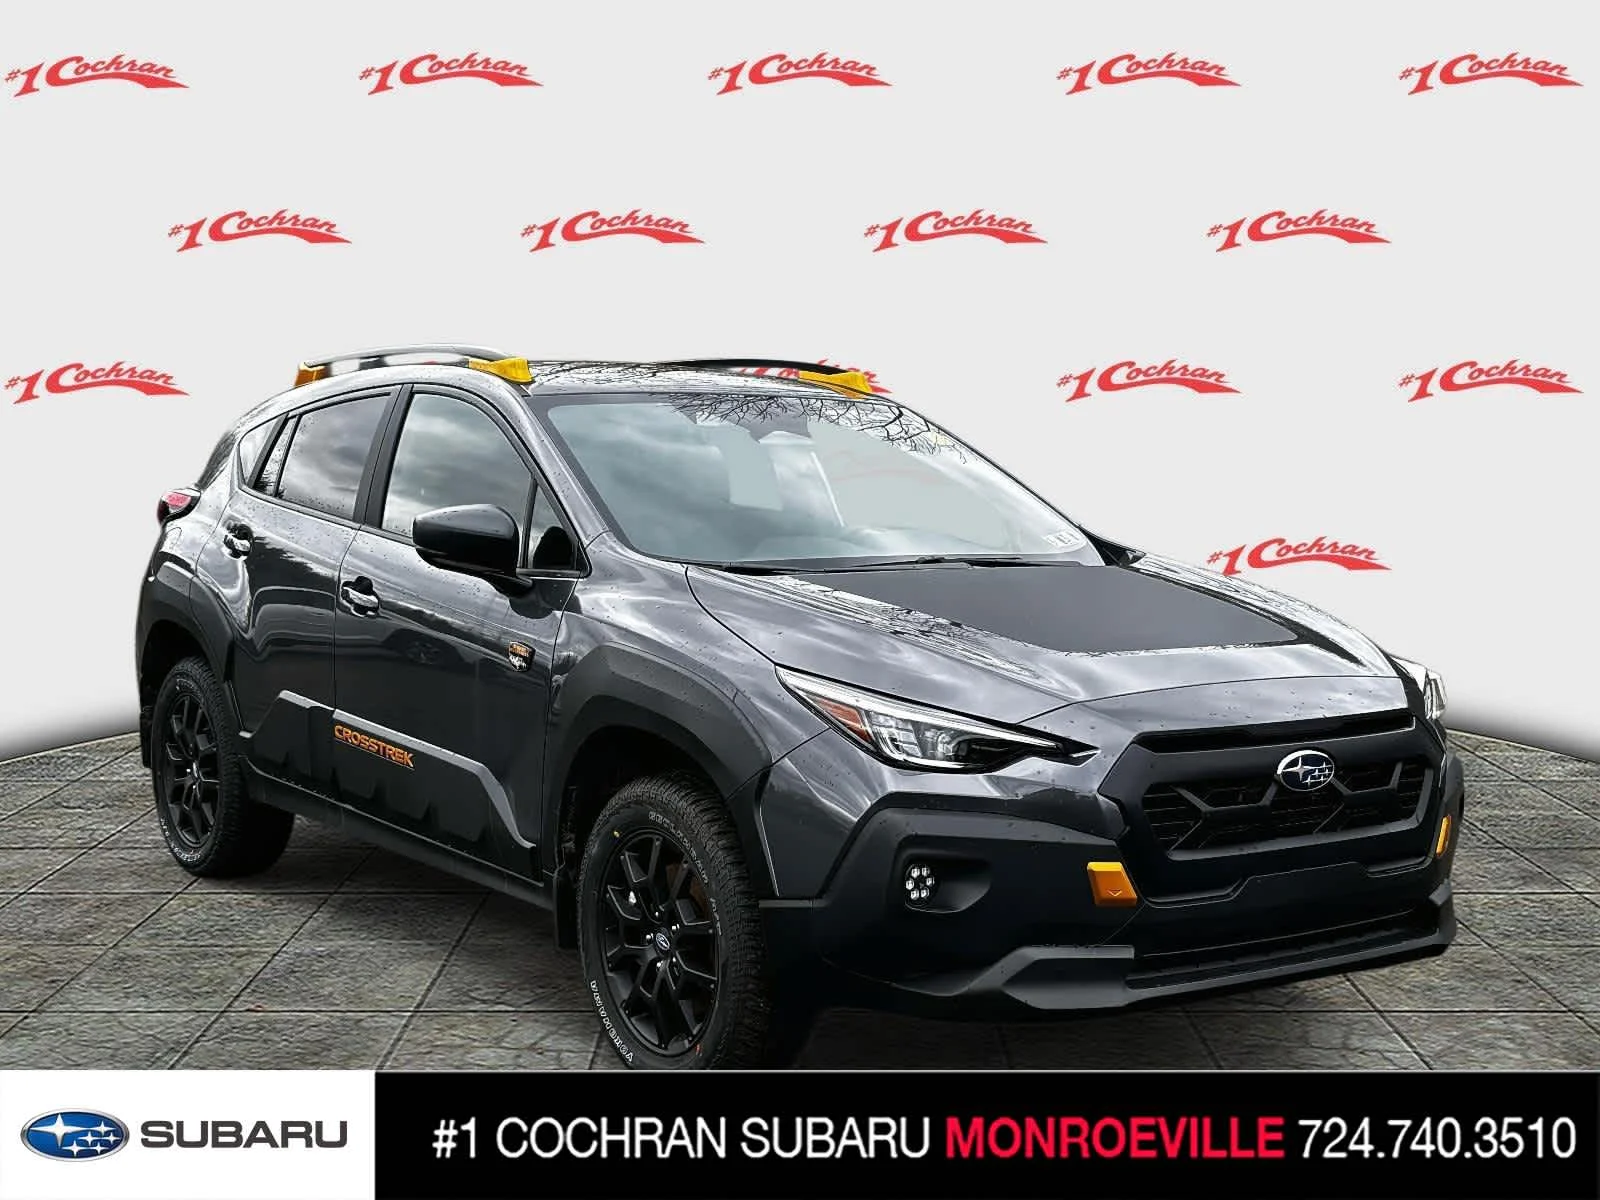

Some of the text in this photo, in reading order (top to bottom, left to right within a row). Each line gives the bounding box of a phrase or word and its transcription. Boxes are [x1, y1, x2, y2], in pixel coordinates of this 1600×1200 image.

[5, 53, 186, 96] #1 Cochran
[360, 52, 539, 95] #1 Cochran
[710, 51, 889, 95] #1 Cochran
[1059, 51, 1237, 95] #1 Cochran
[1400, 51, 1578, 95] #1 Cochran
[170, 209, 349, 253] #1 Cochran
[523, 209, 702, 252] #1 Cochran
[865, 208, 1045, 252] #1 Cochran
[1208, 208, 1388, 252] #1 Cochran
[6, 360, 186, 403] #1 Cochran
[1057, 359, 1239, 402] #1 Cochran
[1400, 359, 1580, 402] #1 Cochran
[1207, 534, 1386, 576] #1 Cochran
[334, 724, 415, 768] CROSSTREK
